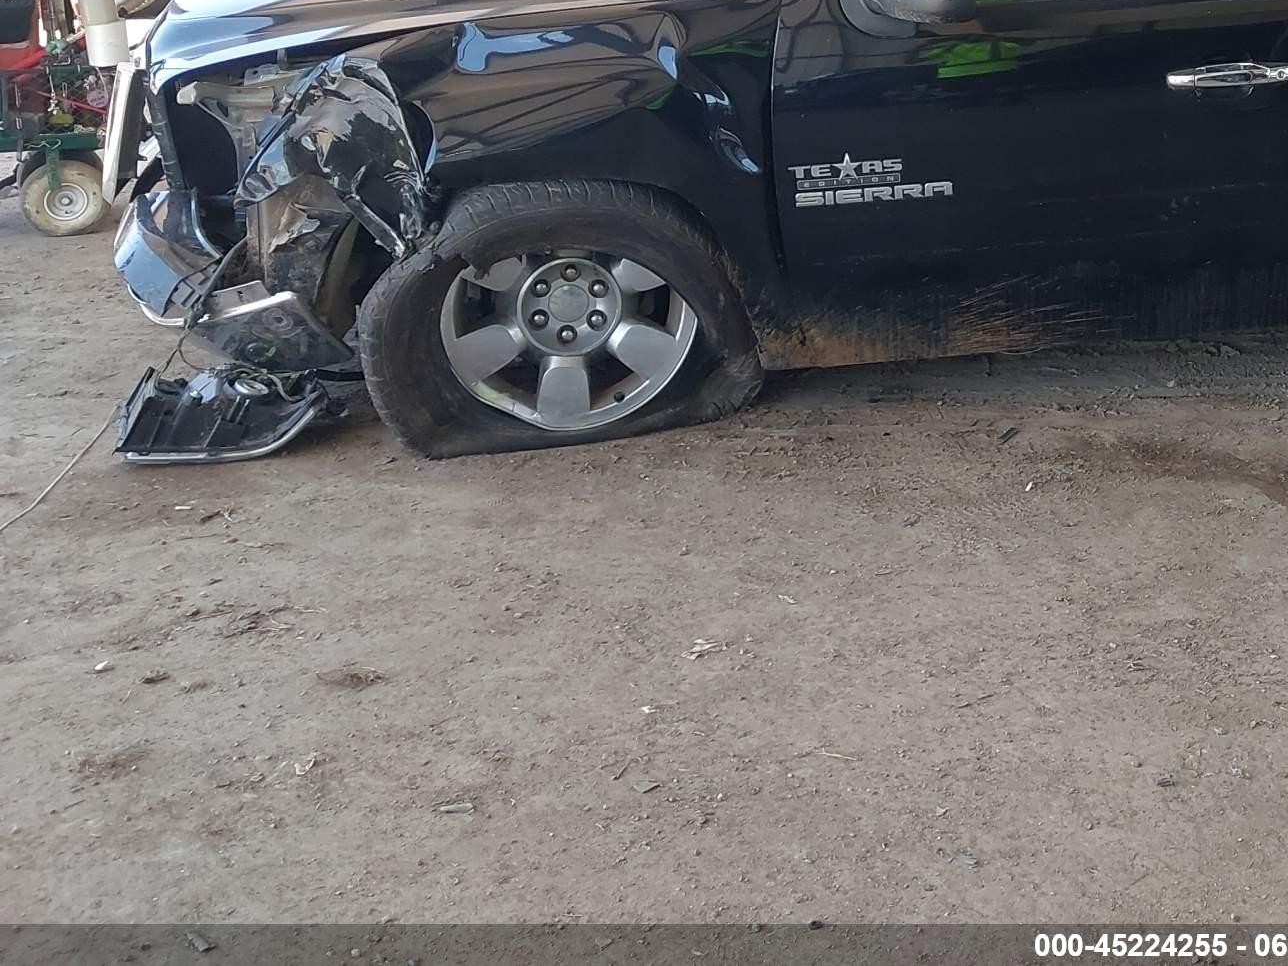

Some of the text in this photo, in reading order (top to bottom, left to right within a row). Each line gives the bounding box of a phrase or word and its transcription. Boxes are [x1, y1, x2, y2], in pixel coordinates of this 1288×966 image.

[787, 152, 903, 181] TEXAS
[795, 181, 954, 208] SIERRA
[802, 175, 896, 188] EDITION
